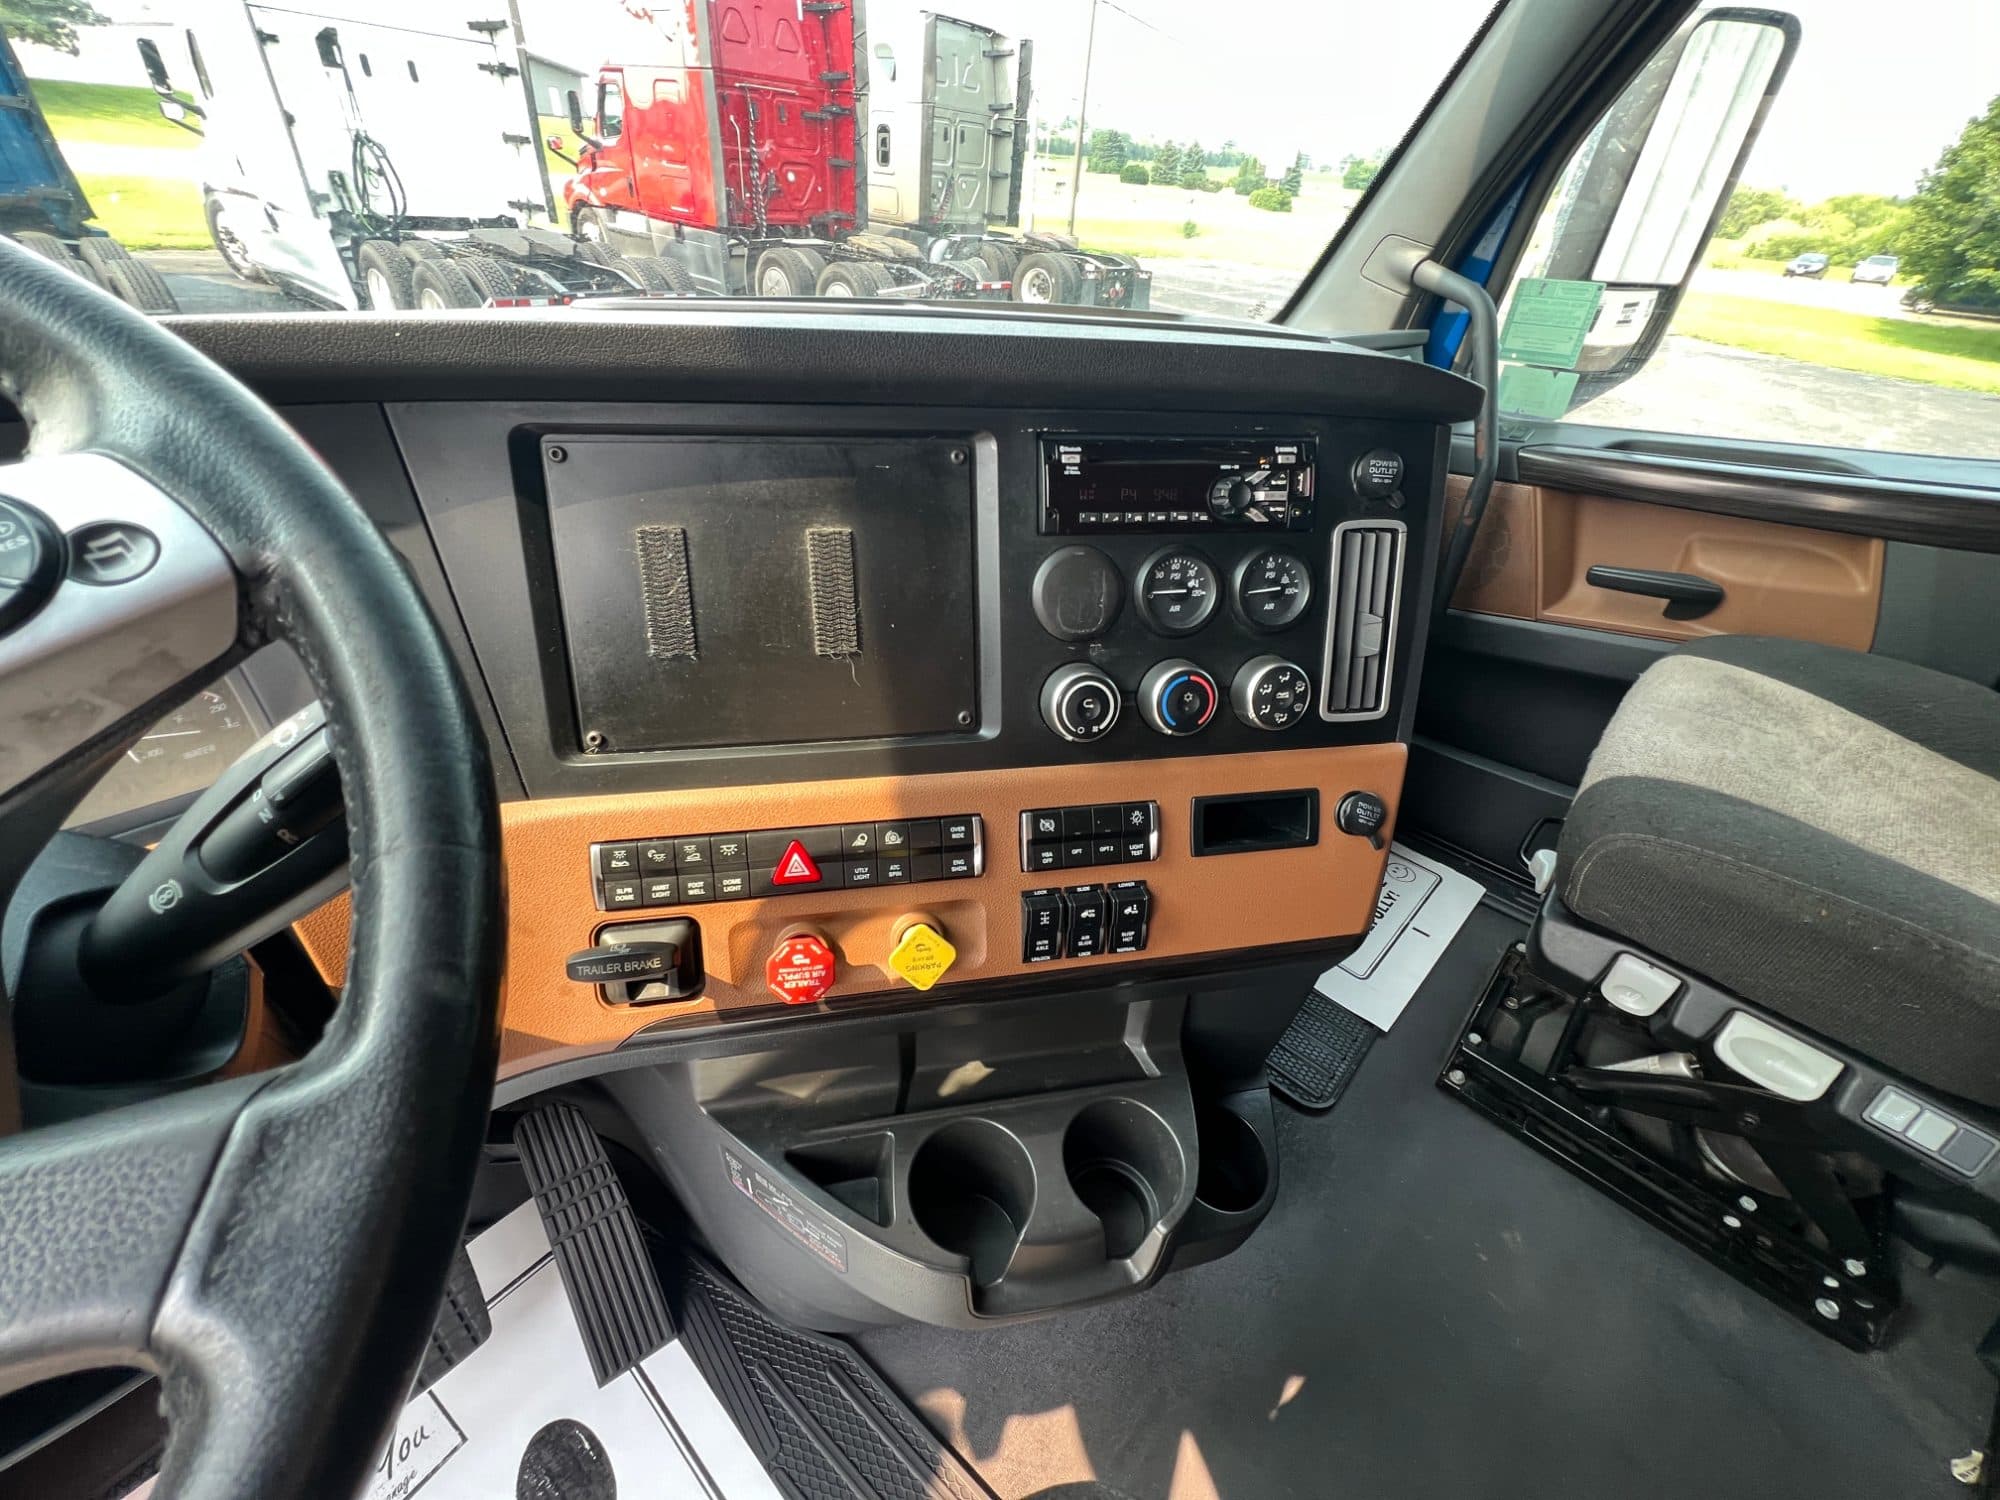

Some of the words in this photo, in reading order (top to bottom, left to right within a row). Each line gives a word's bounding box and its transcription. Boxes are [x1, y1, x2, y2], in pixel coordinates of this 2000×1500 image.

[1369, 467, 1398, 475] OUTLET
[1169, 572, 1182, 580] PSI
[1265, 571, 1276, 579] PSI
[1168, 605, 1182, 613] AIR
[1358, 802, 1381, 813] POWER
[259, 808, 273, 824] N
[1356, 808, 1380, 818] OUTLET
[853, 873, 870, 881] LIGHT
[687, 881, 705, 889] FOOT
[722, 878, 742, 886] DOME
[723, 885, 742, 893] LIGHT
[615, 894, 635, 902] DOME
[651, 890, 671, 899] LIGHT
[1368, 890, 1400, 934] FULLY!
[576, 963, 623, 977] TRAILER
[623, 957, 662, 972] BRAKE
[906, 962, 942, 972] PARKING
[776, 970, 810, 981] SUPPLY
[812, 969, 826, 979] AIR
[783, 979, 821, 989] TRAILER
